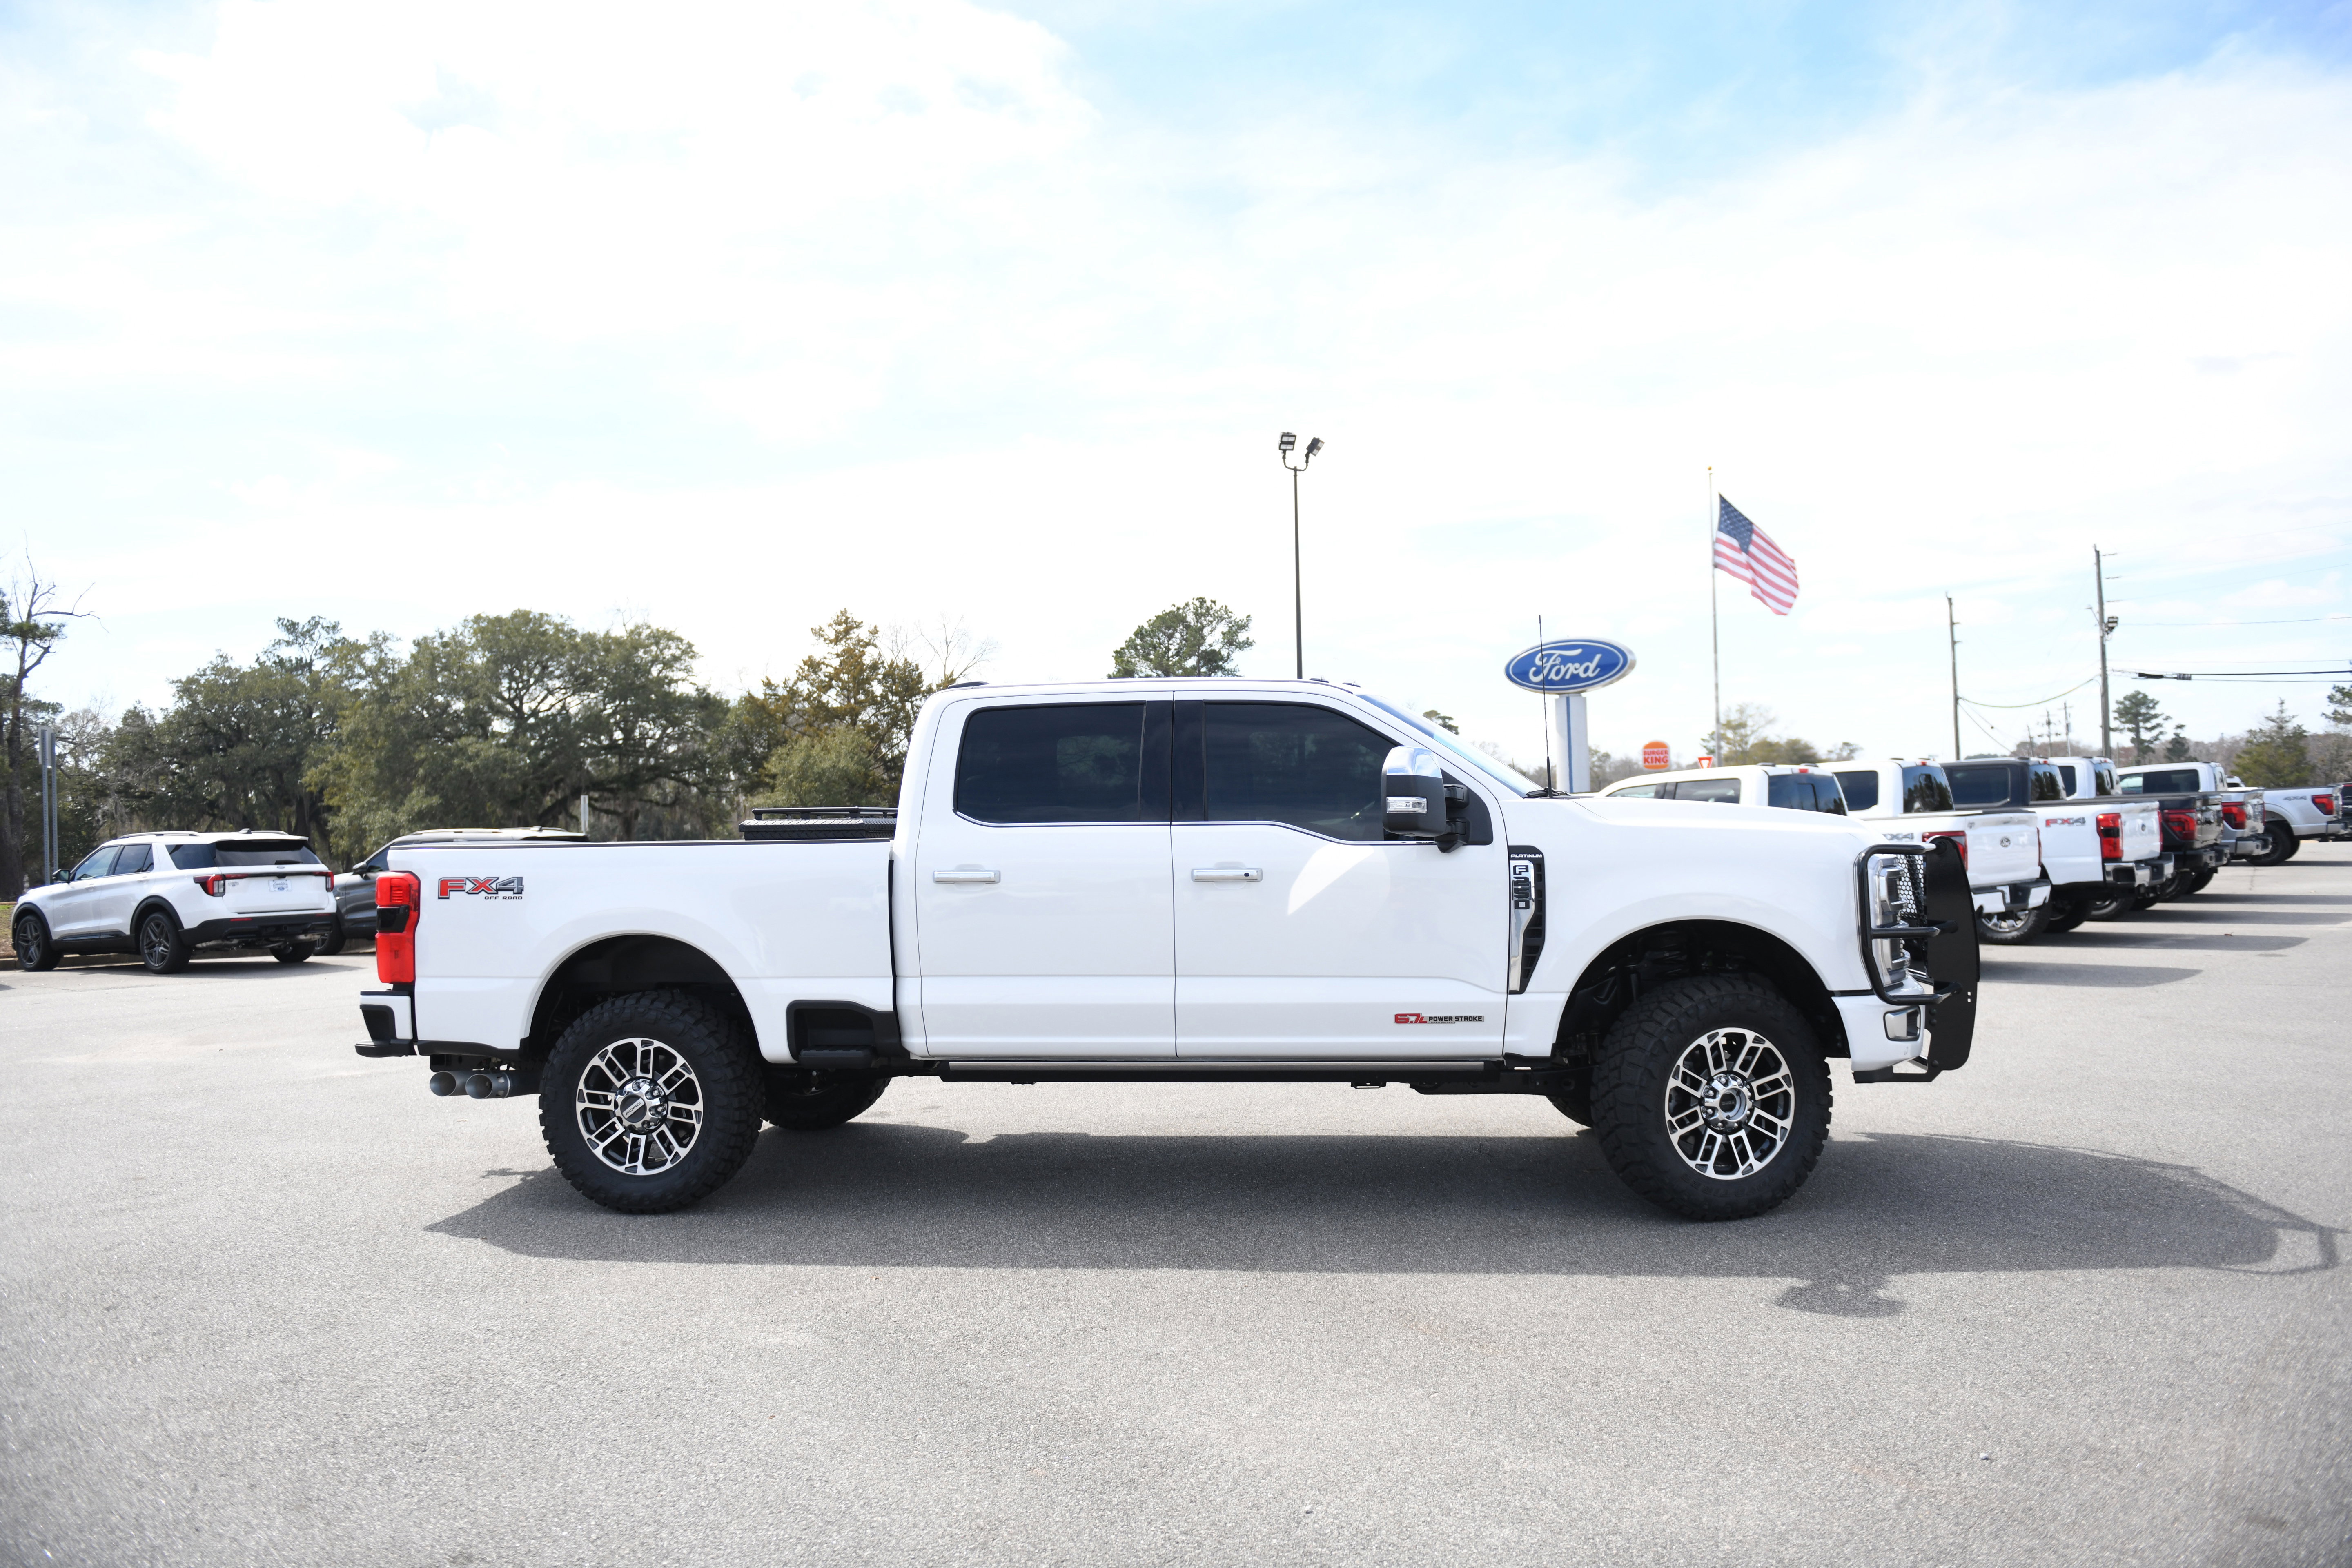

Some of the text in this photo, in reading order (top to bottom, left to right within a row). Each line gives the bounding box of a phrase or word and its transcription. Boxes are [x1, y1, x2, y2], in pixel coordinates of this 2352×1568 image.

[1529, 648, 1602, 682] Ford
[2045, 817, 2085, 826] FX4
[438, 877, 524, 899] FX4
[626, 1102, 641, 1116] FORD
